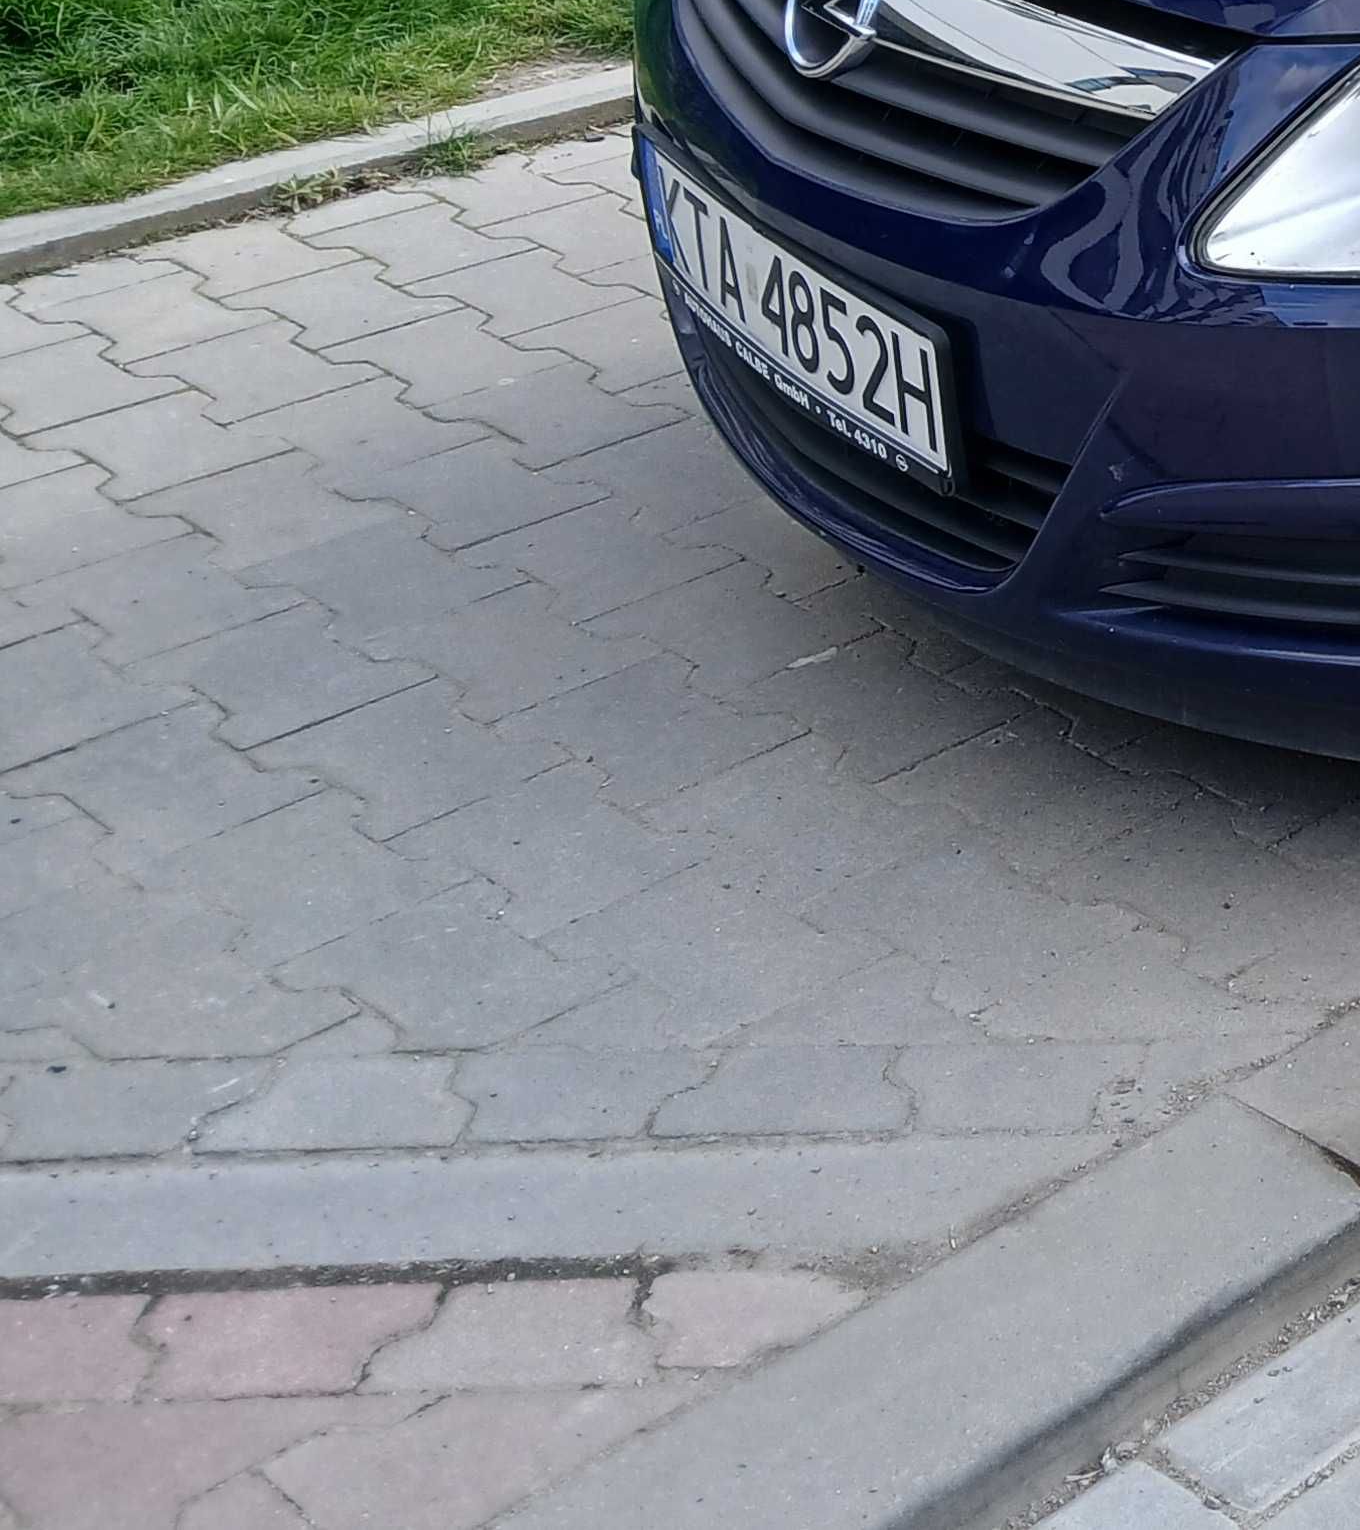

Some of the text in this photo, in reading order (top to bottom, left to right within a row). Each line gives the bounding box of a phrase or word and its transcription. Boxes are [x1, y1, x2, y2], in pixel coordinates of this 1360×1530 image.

[657, 166, 938, 453] KTA 4852H
[736, 343, 770, 381] CALBE
[774, 374, 811, 413] GmbH
[853, 429, 888, 460] 4310
